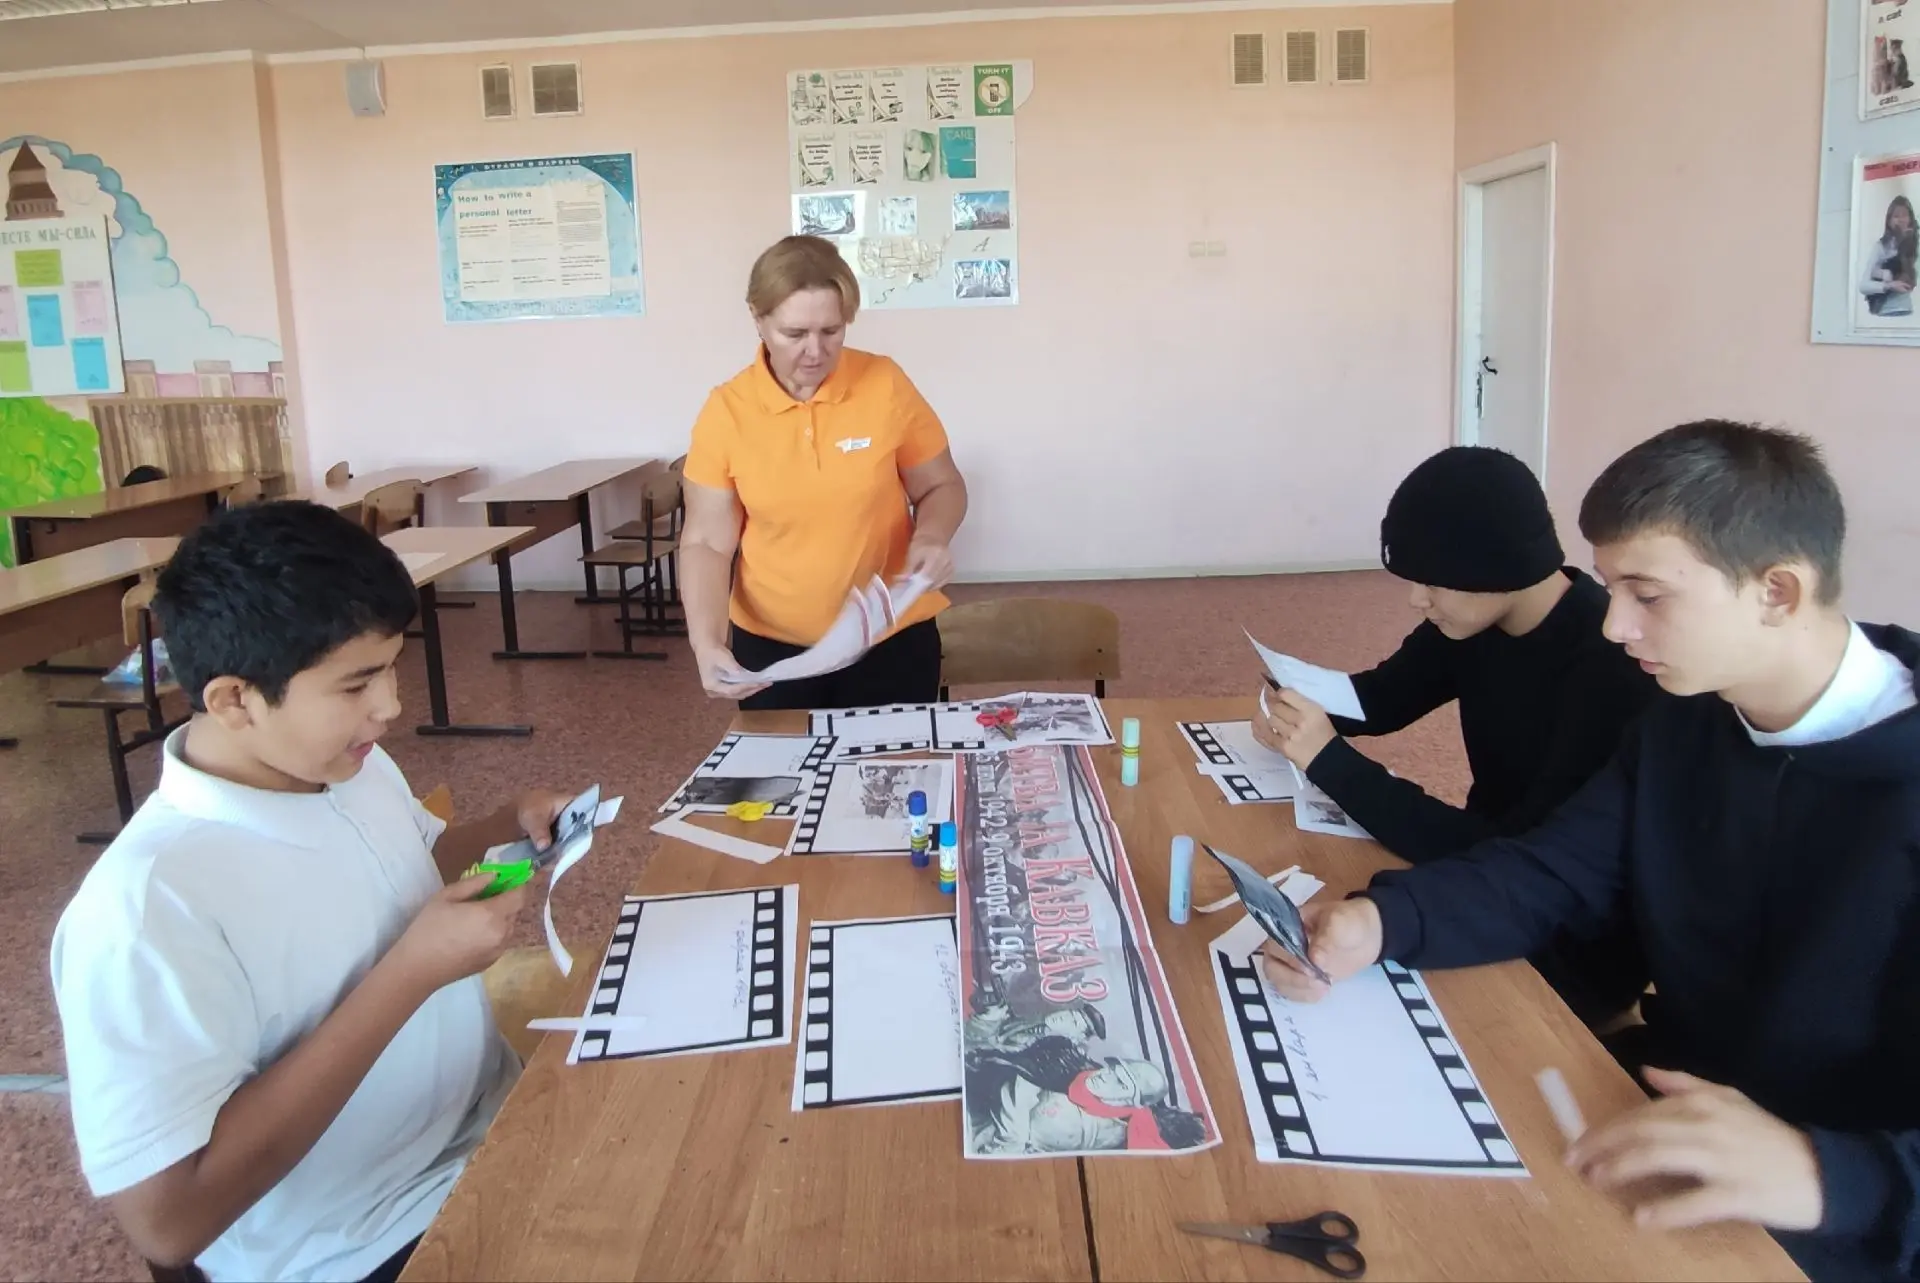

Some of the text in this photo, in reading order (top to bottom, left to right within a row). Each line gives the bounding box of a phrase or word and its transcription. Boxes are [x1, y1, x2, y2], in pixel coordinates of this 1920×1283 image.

[1886, 9, 1902, 21] cat
[1879, 95, 1899, 106] cats
[458, 194, 479, 203] How
[484, 193, 494, 202] to
[498, 191, 523, 201] write
[459, 207, 533, 219] personal letter
[38, 226, 97, 242] МЫ-СИЛА
[978, 796, 1008, 829] 1942
[976, 847, 1021, 917] октября
[1023, 856, 1109, 1003] КАВКАЗ
[987, 925, 1028, 975] 1943
